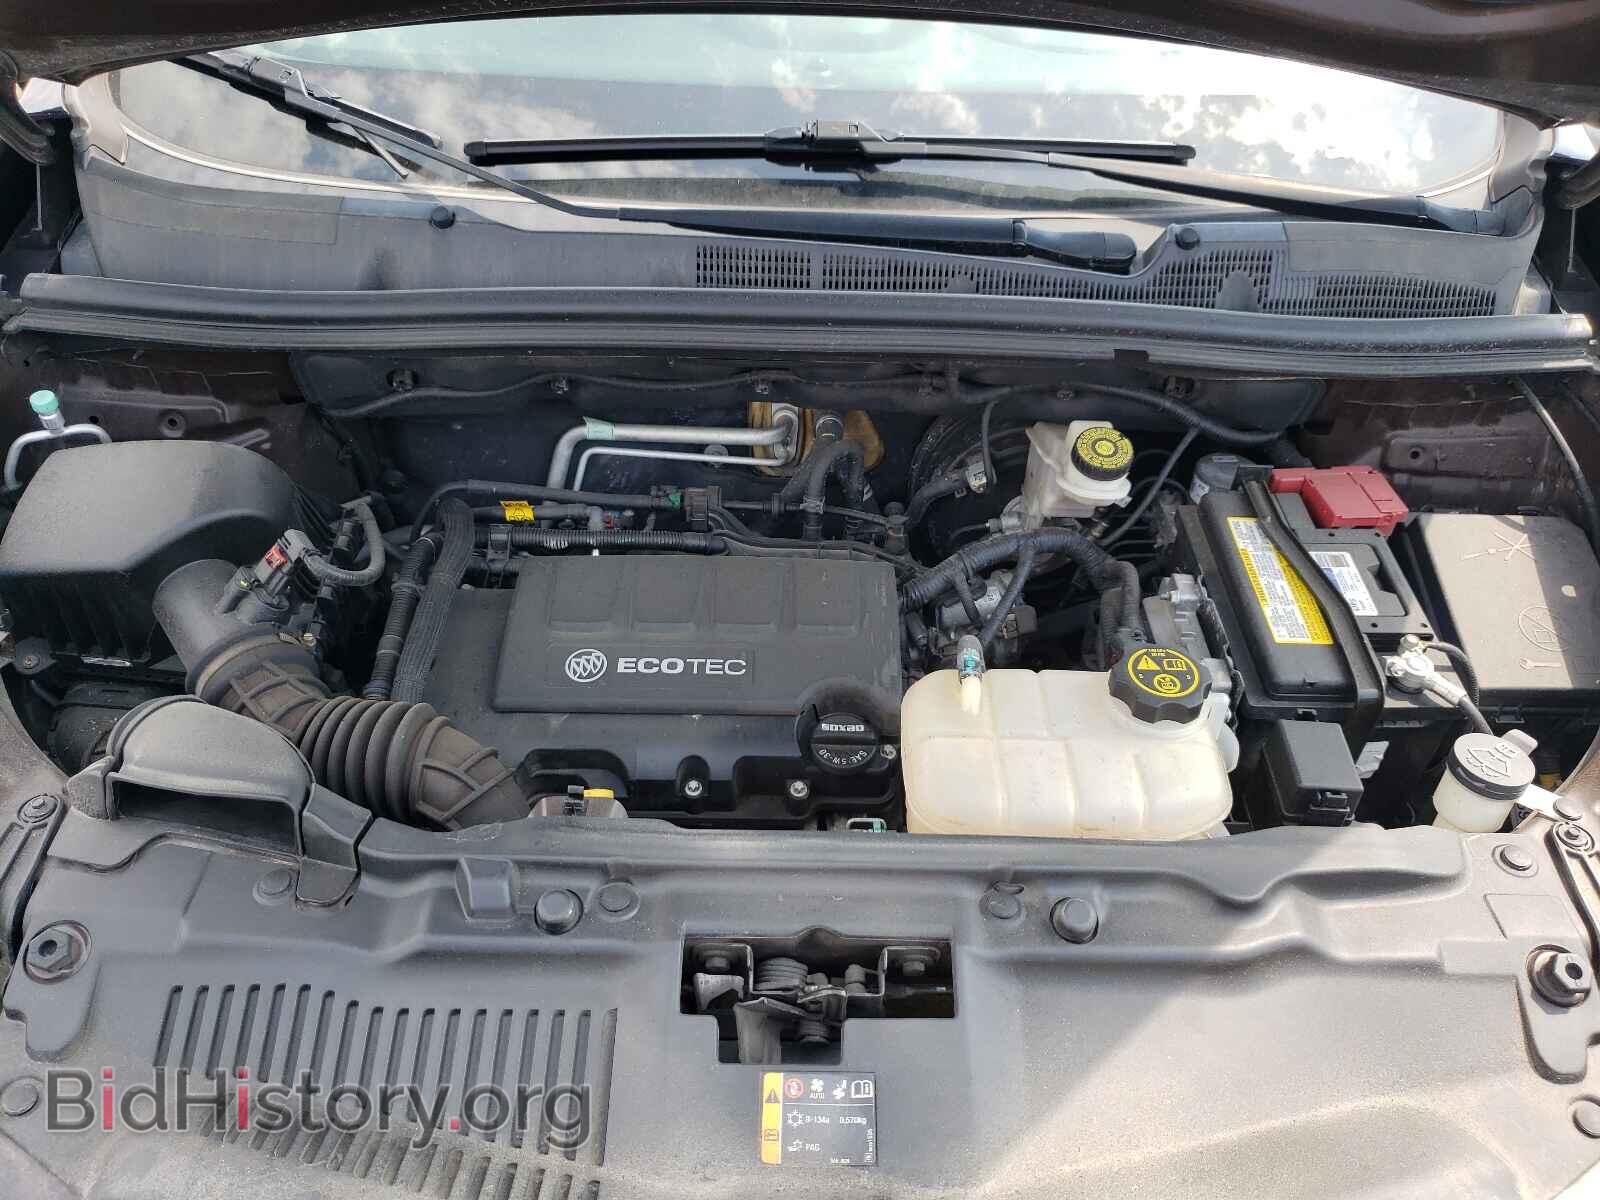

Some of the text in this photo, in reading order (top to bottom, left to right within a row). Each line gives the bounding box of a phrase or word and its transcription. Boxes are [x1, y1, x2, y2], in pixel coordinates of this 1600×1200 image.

[616, 657, 747, 676] ECOTEC
[818, 748, 868, 765] SAE 5W-30
[805, 1143, 820, 1151] PAG
